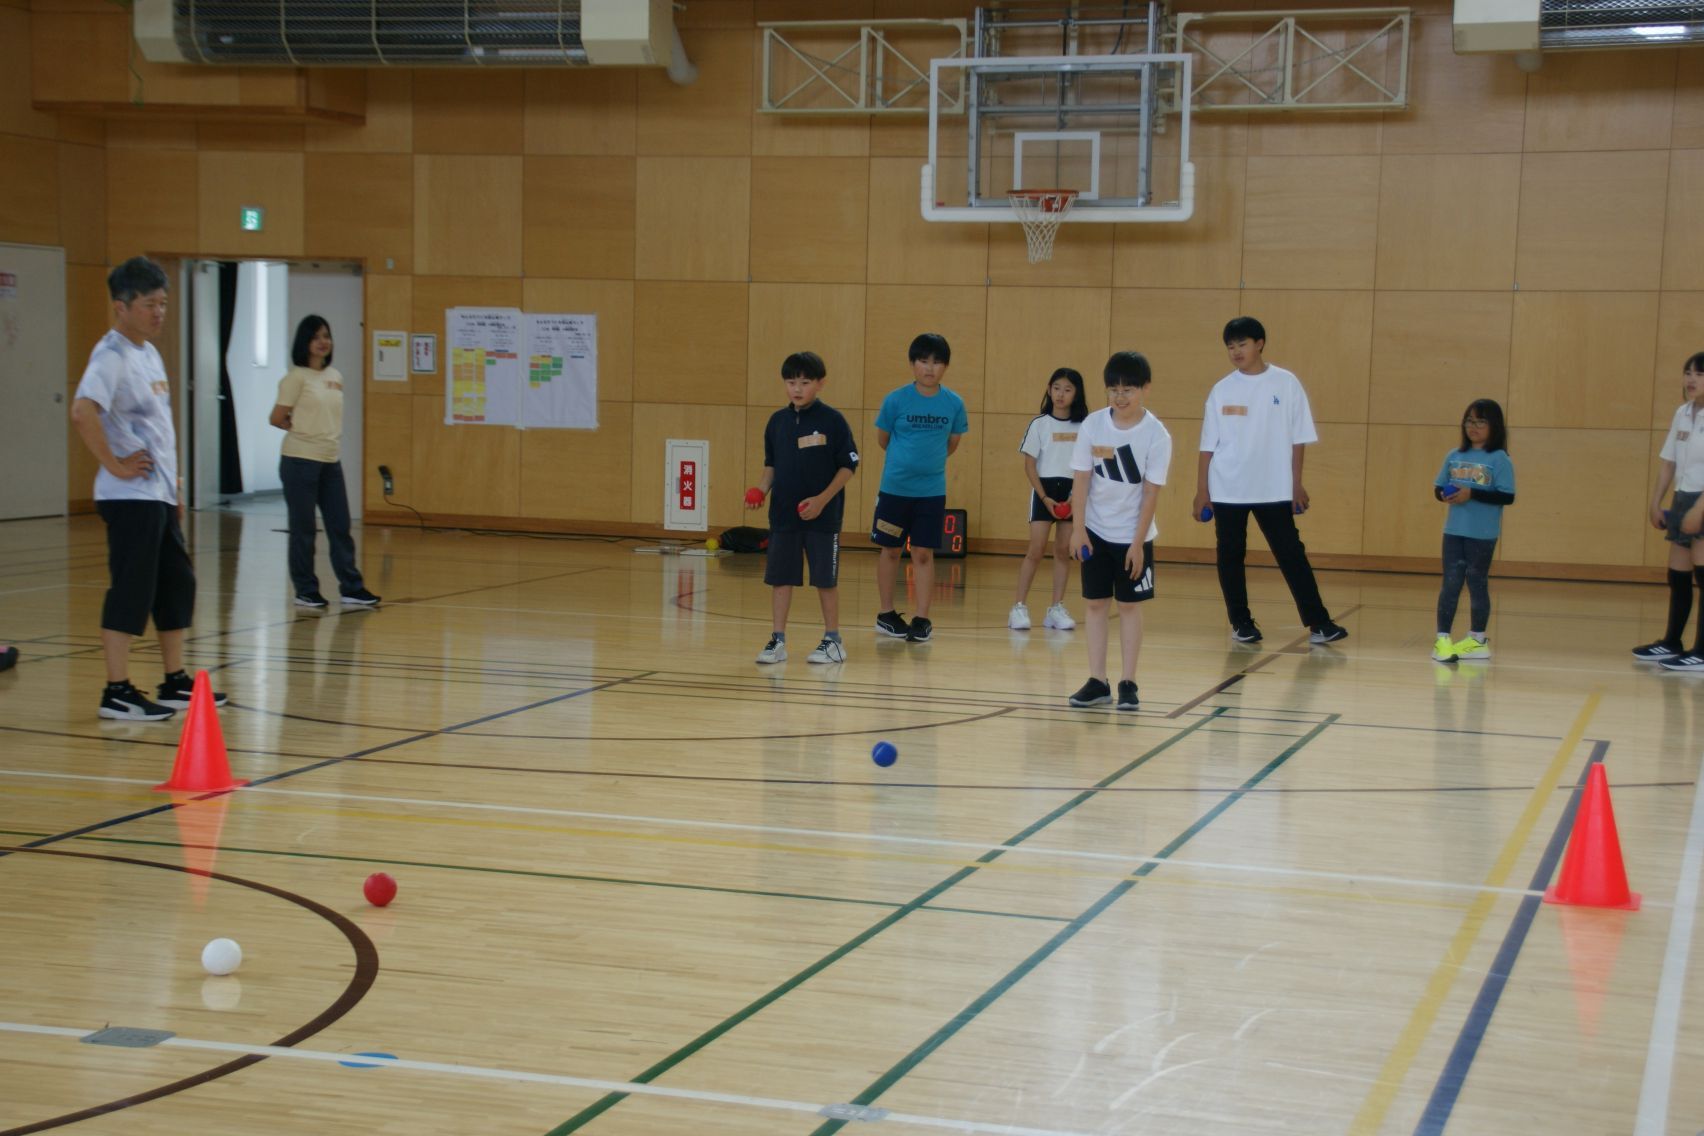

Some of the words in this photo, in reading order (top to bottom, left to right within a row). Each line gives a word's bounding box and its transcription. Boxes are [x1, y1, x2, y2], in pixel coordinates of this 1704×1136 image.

[906, 414, 949, 425] umbro
[945, 515, 955, 534] 0
[952, 535, 962, 552] 0
